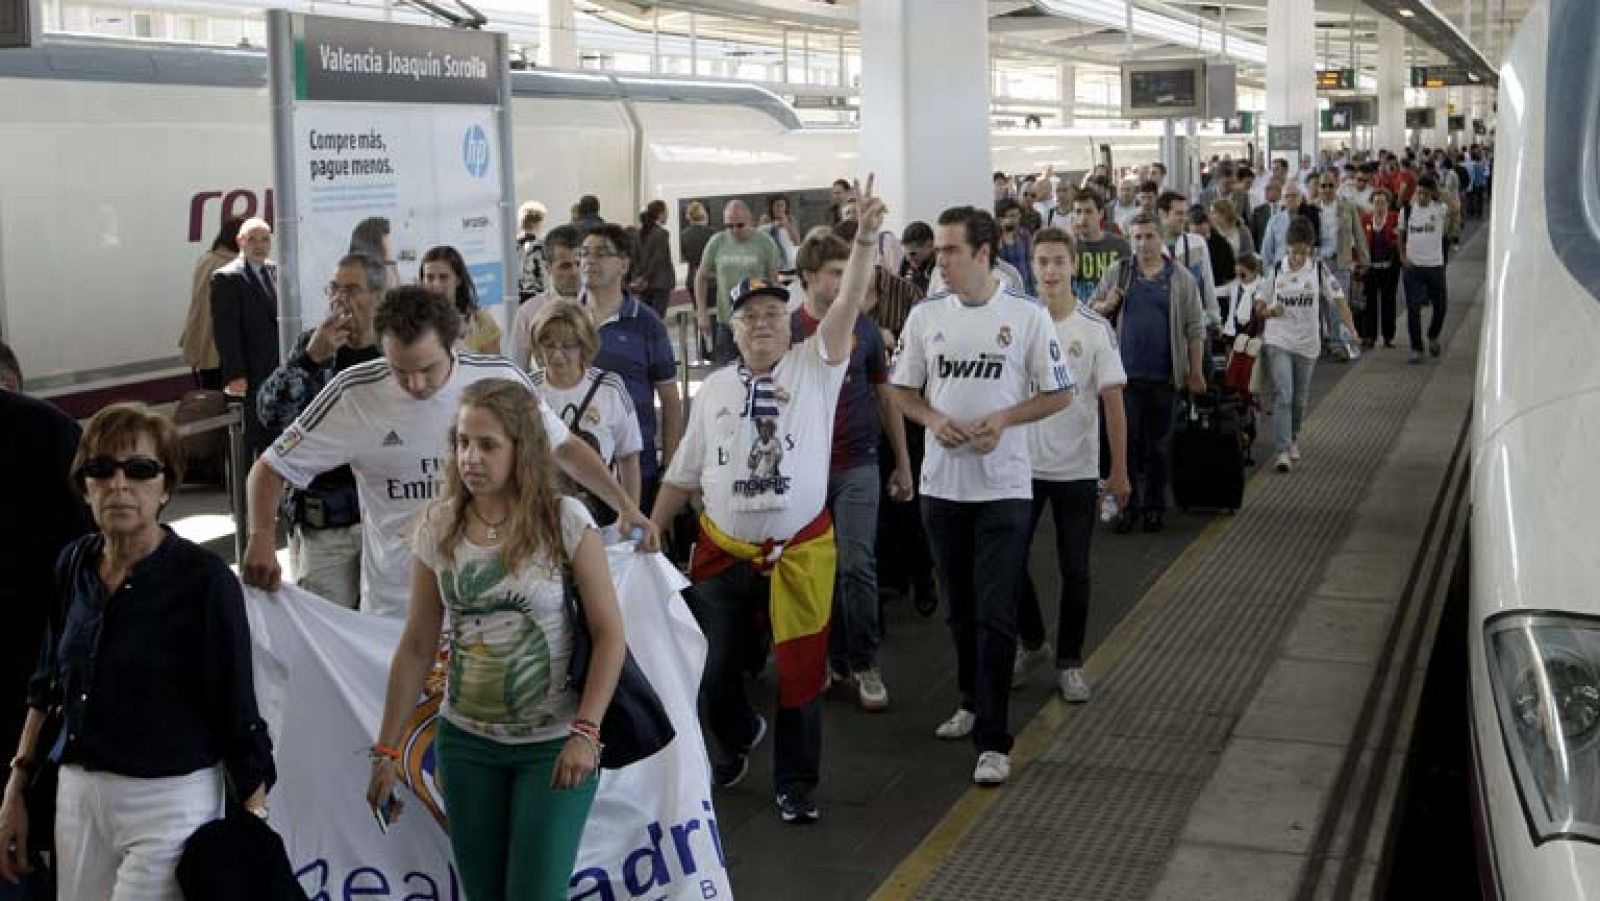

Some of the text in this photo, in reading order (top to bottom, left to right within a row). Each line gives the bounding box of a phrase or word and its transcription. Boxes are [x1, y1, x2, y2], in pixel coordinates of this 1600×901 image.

[320, 43, 382, 72] Valencia
[444, 54, 487, 78] Sorolla
[309, 129, 356, 153] Compre
[310, 158, 394, 180] pague menos.
[938, 353, 1003, 380] bwin
